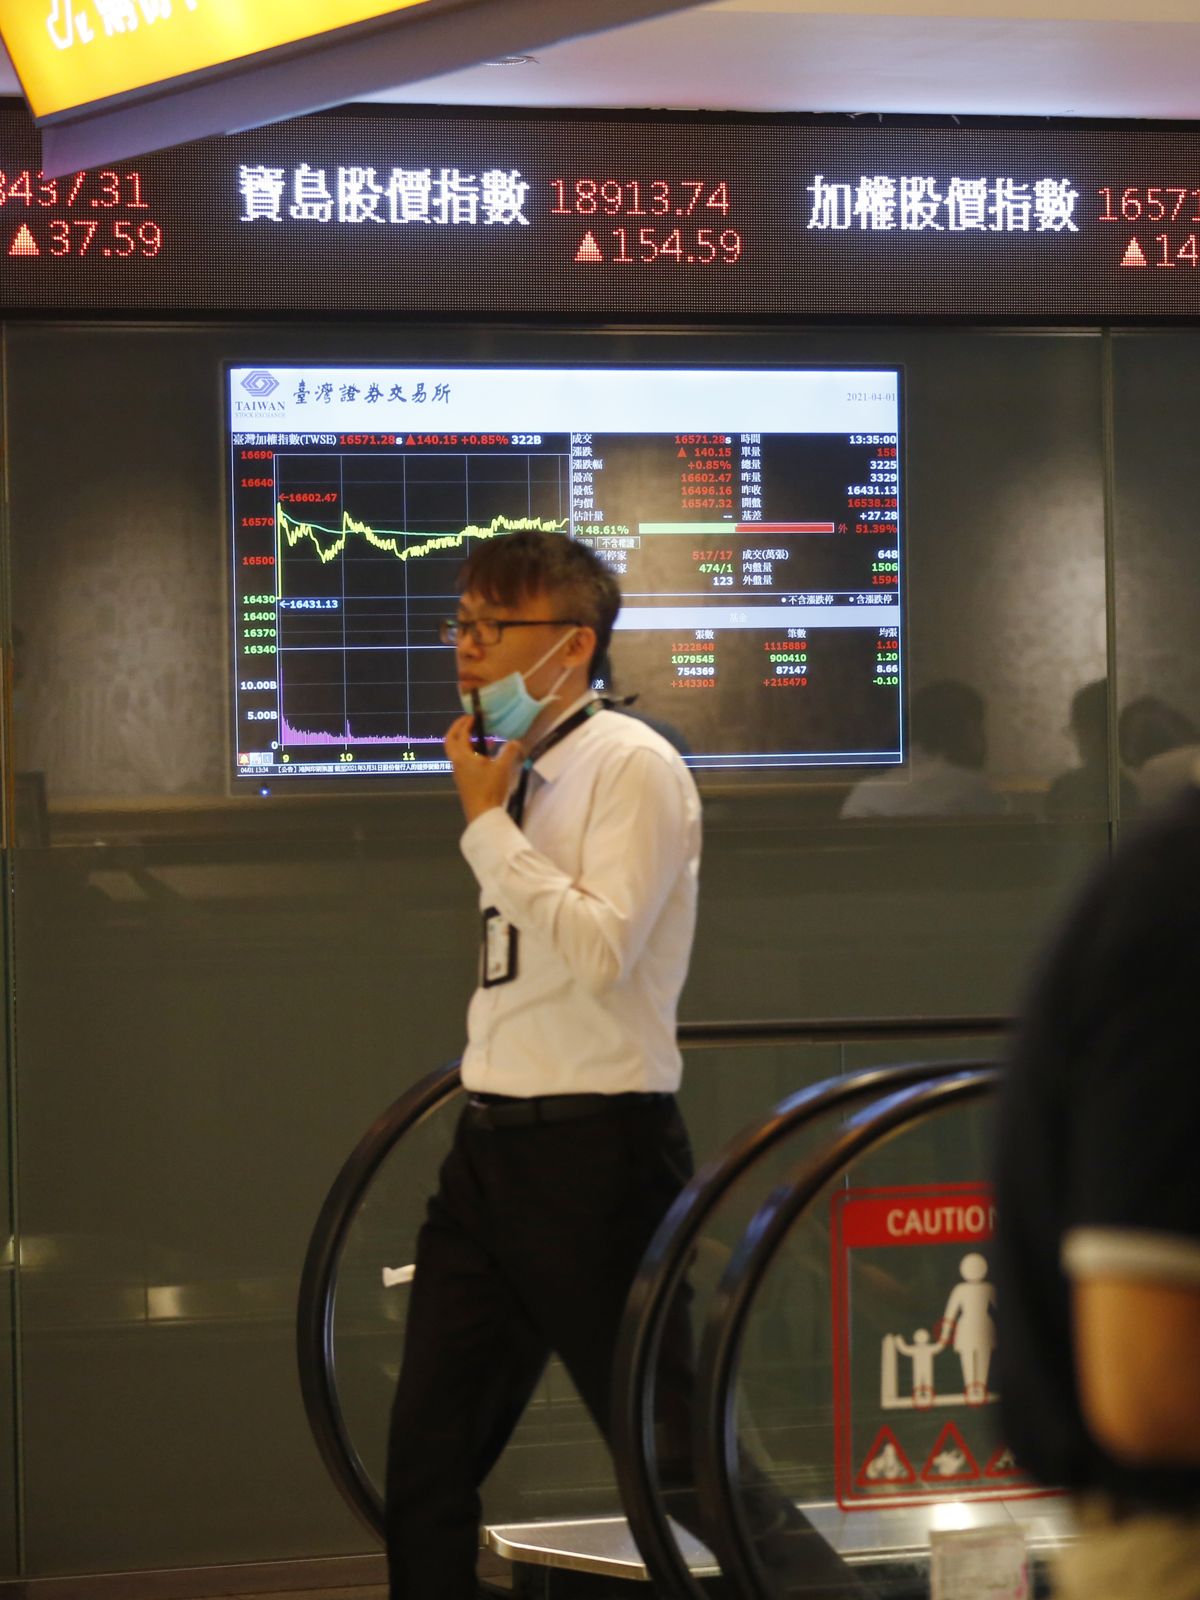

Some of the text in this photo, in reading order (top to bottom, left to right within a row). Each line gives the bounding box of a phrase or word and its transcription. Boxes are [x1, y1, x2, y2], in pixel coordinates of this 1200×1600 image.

[0, 170, 148, 207] 437.31
[239, 163, 531, 226] 寶島股價指數
[551, 180, 731, 217] 18913.74
[806, 175, 1080, 233] 加權股價指數
[50, 220, 162, 256] 37.59
[611, 228, 743, 263] 154.59
[293, 379, 452, 405] 臺灣證券交易所
[846, 393, 896, 402] 2021-04-01
[235, 401, 285, 411] TAIWAN
[417, 435, 458, 445] 140.15
[461, 435, 509, 445] +0.85%
[511, 435, 542, 445] 322B
[572, 433, 897, 445] 成交 時間 13:35:00
[572, 446, 897, 457] 漲跌 140.15 單量 158
[688, 460, 732, 470] +0.85%
[741, 459, 761, 470] 總量
[870, 461, 897, 470] 3225
[573, 472, 593, 483] 最高
[681, 473, 732, 482] 16602.47
[870, 473, 897, 482] 3329
[573, 484, 594, 496] 最低
[681, 486, 733, 495] 16496.16
[847, 486, 898, 495] 16431.13
[289, 493, 338, 502] 16602.47
[681, 499, 733, 508] 16547.32
[848, 499, 898, 508] 16538.28
[860, 511, 898, 521] +27.28
[242, 518, 274, 526] 16570
[585, 525, 629, 535] 48.61%
[855, 524, 898, 533] 51.39%
[691, 551, 733, 560] 517/17
[877, 550, 898, 559] 648
[242, 556, 275, 565] 16500
[698, 563, 898, 573] 474/1 1506
[713, 576, 734, 586] 123
[872, 576, 898, 585] 1594
[243, 595, 276, 604] 16430
[290, 600, 338, 609] 16431.13
[243, 612, 276, 621] 16400
[243, 629, 276, 637] 16370
[244, 645, 277, 654] 16340
[876, 640, 898, 649] 1.10
[671, 652, 898, 664] 1079545 900410 1.20
[677, 665, 898, 676] 754369 87147 8.66
[240, 681, 277, 690] 10.00B
[873, 676, 898, 686] -0.10
[247, 711, 278, 720] 5.00B
[282, 752, 416, 763] 9 10 11
